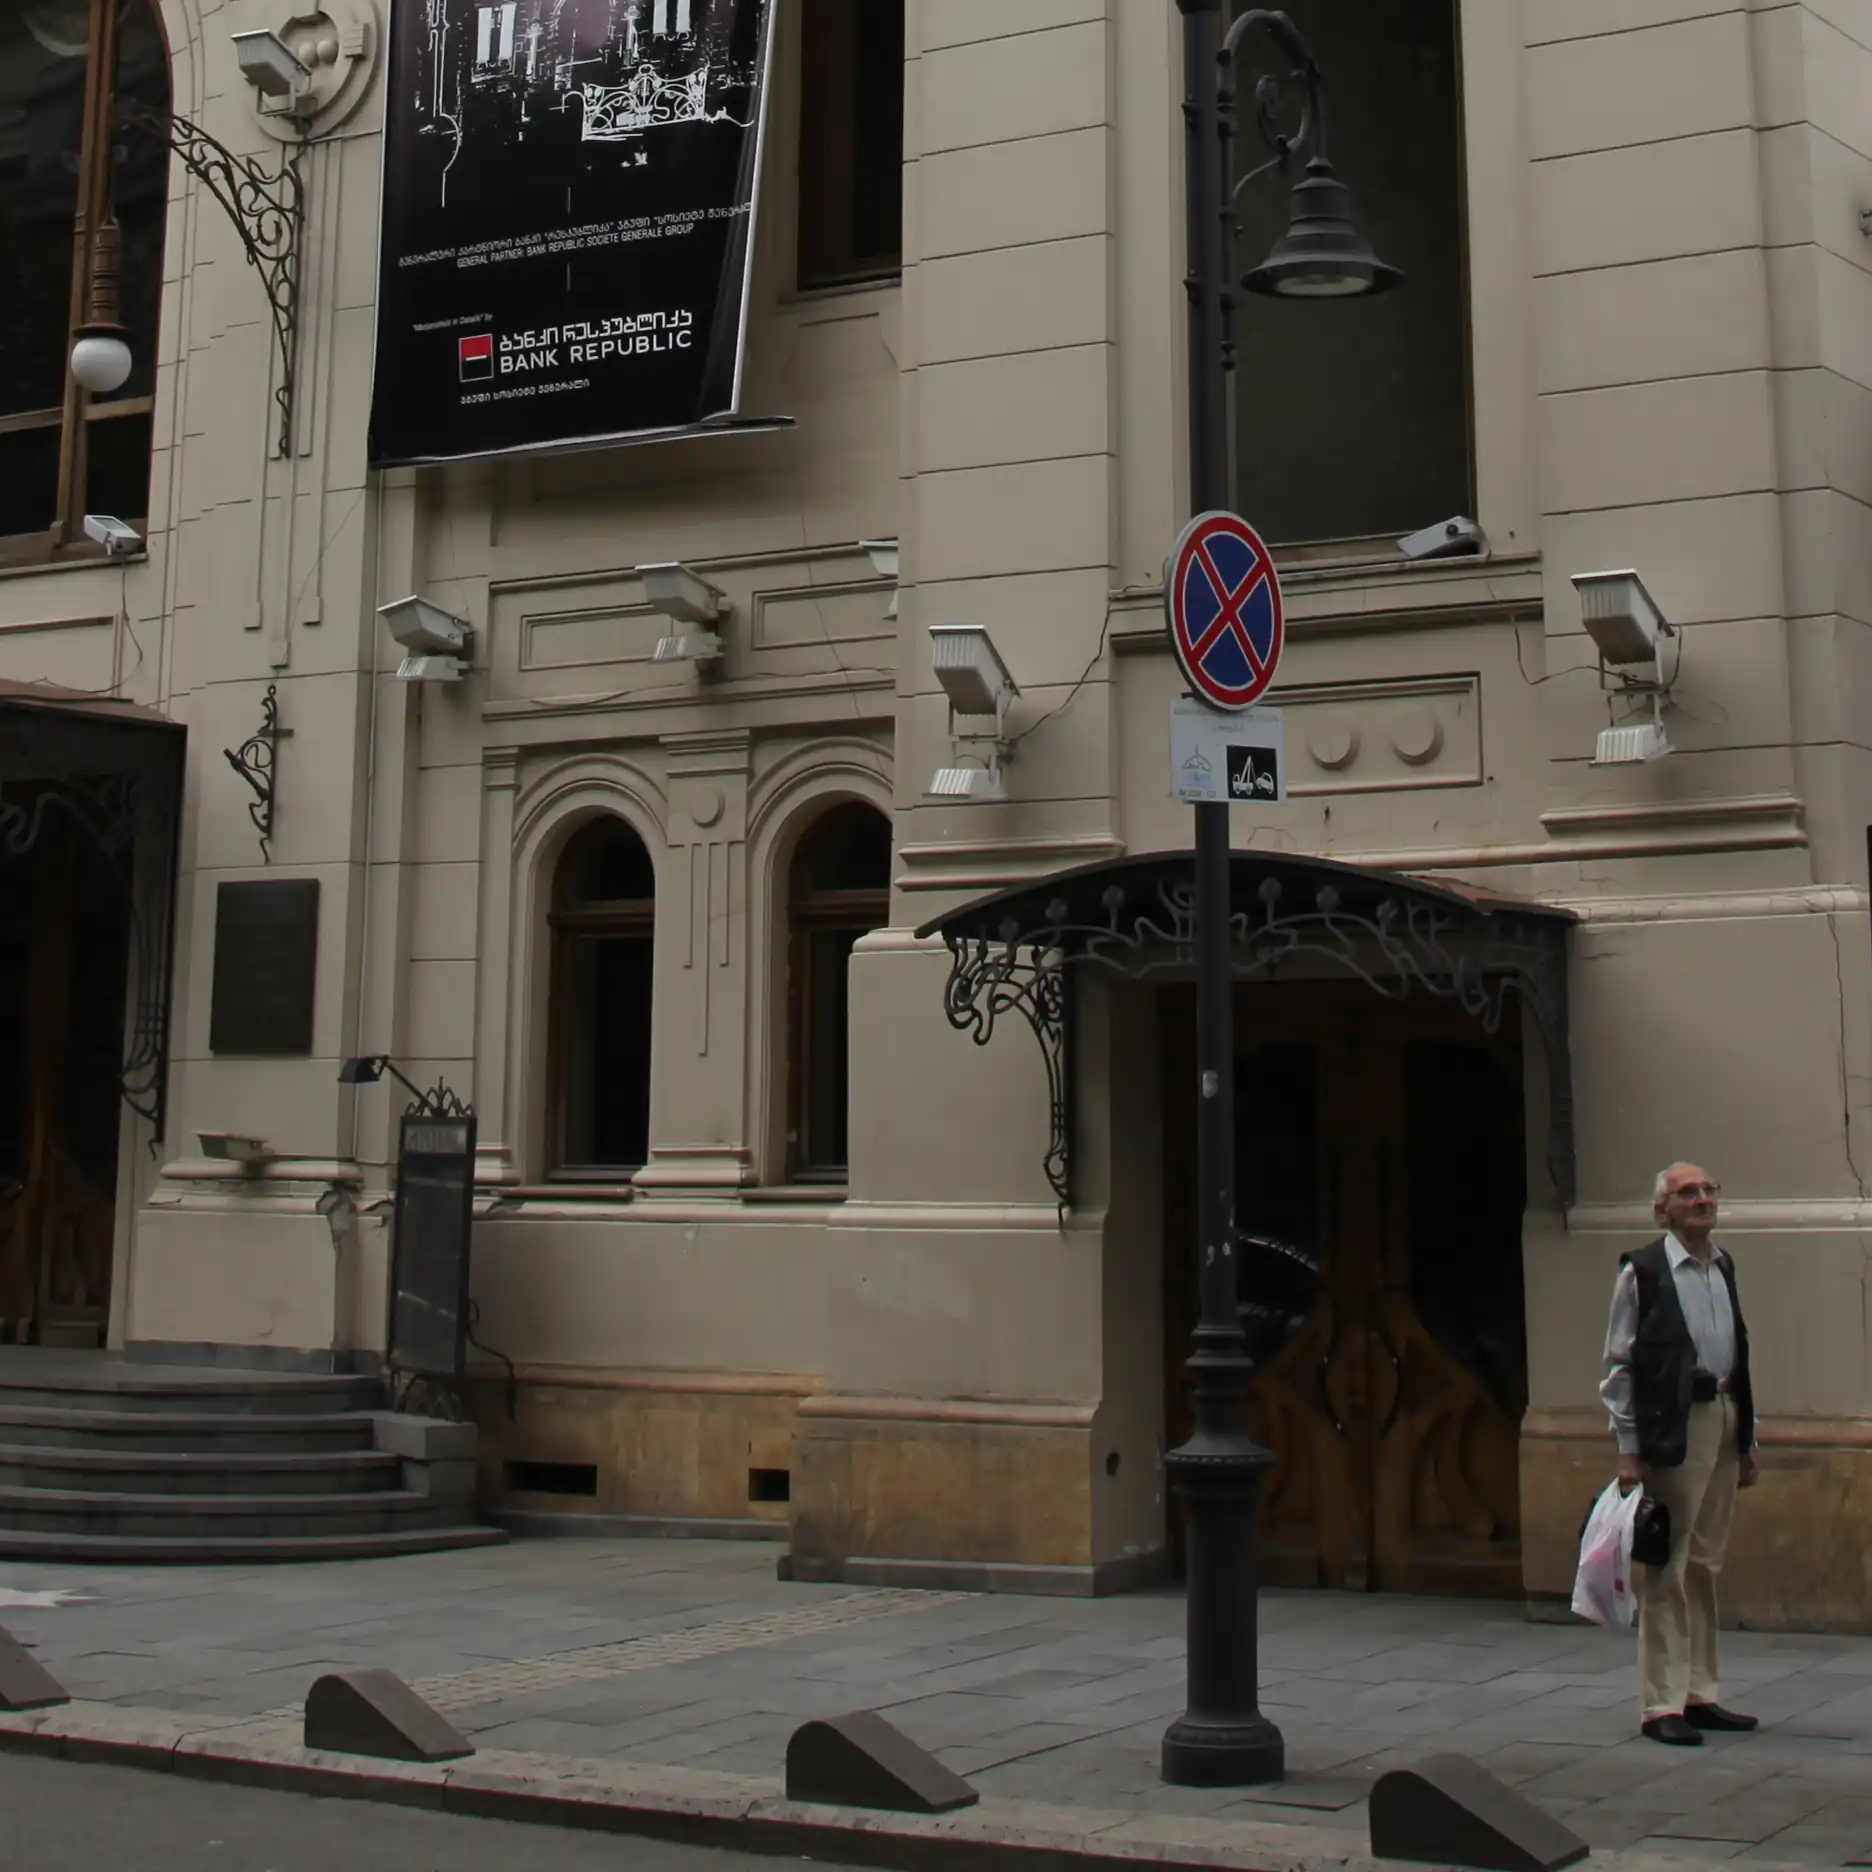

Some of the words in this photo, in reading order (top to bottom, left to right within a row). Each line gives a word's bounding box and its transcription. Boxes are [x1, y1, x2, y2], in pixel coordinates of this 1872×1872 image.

[457, 253, 489, 268] GENERAL
[527, 243, 547, 257] BANK
[548, 237, 585, 253] REPUBLIC
[586, 232, 619, 247] SOCIETE
[621, 227, 663, 242] GENERALE
[665, 222, 695, 236] GROUP
[499, 327, 559, 352] ბანკი
[563, 309, 693, 343] რესპუბლიკა
[500, 349, 559, 374] BANK
[570, 329, 693, 364] REPUBLIC
